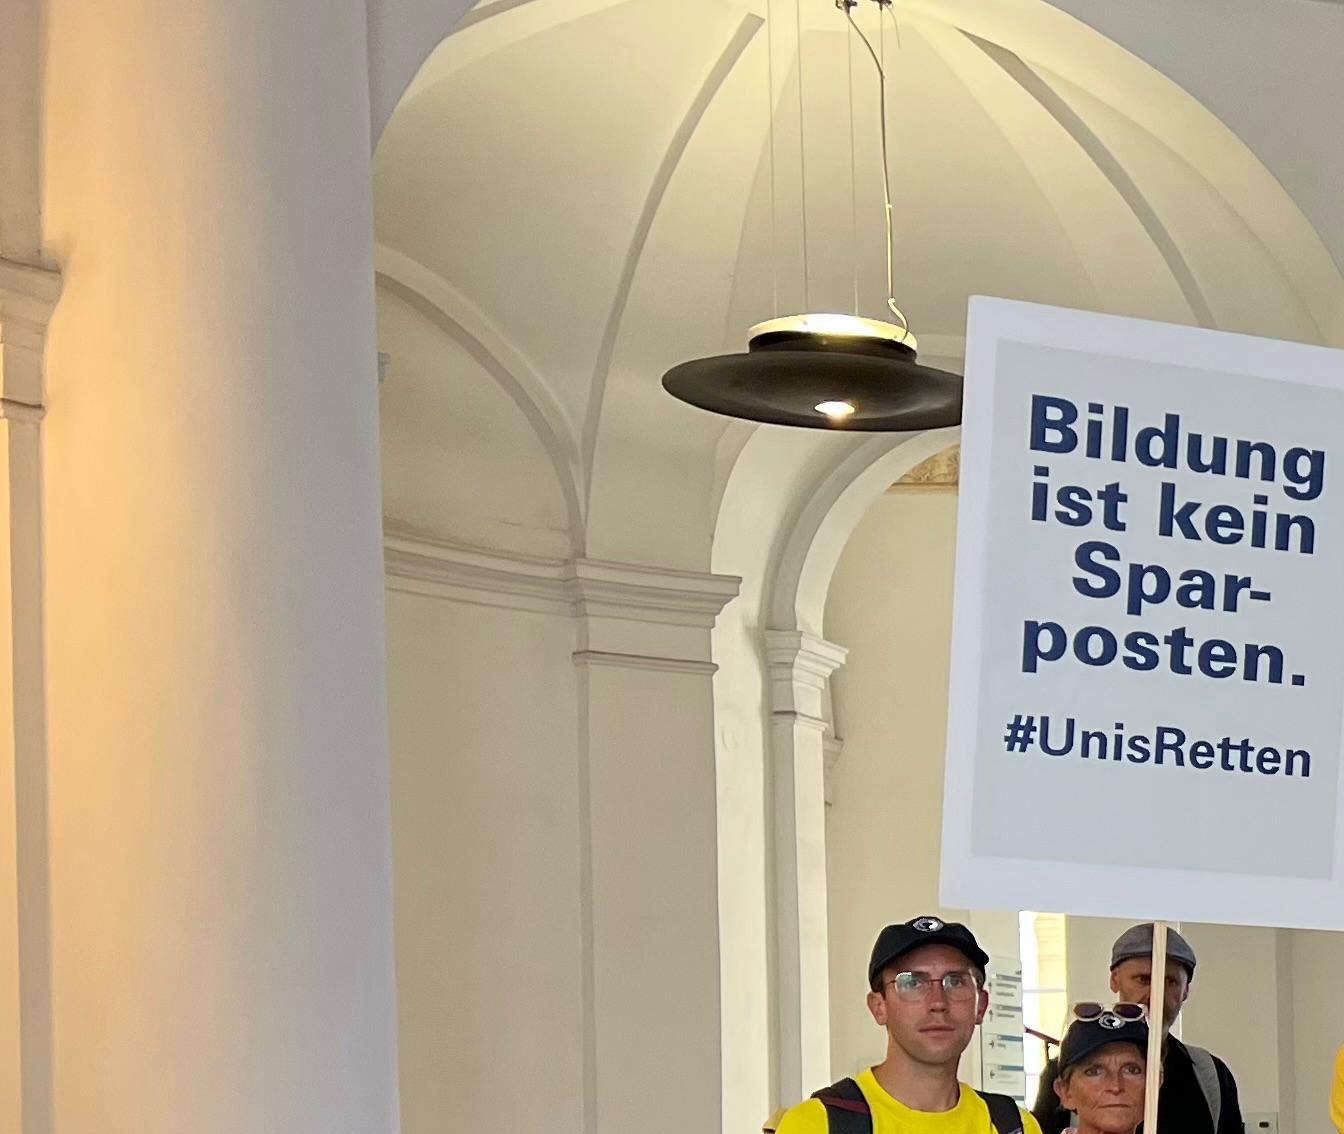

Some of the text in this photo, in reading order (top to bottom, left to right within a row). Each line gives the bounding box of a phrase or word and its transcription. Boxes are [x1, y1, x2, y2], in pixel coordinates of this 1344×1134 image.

[1029, 394, 1326, 502] Bildung
[1031, 465, 1316, 555] ist kein
[1071, 541, 1273, 616] Spar-
[1021, 619, 1307, 688] posten.
[1003, 714, 1312, 778] #UnisRetten
